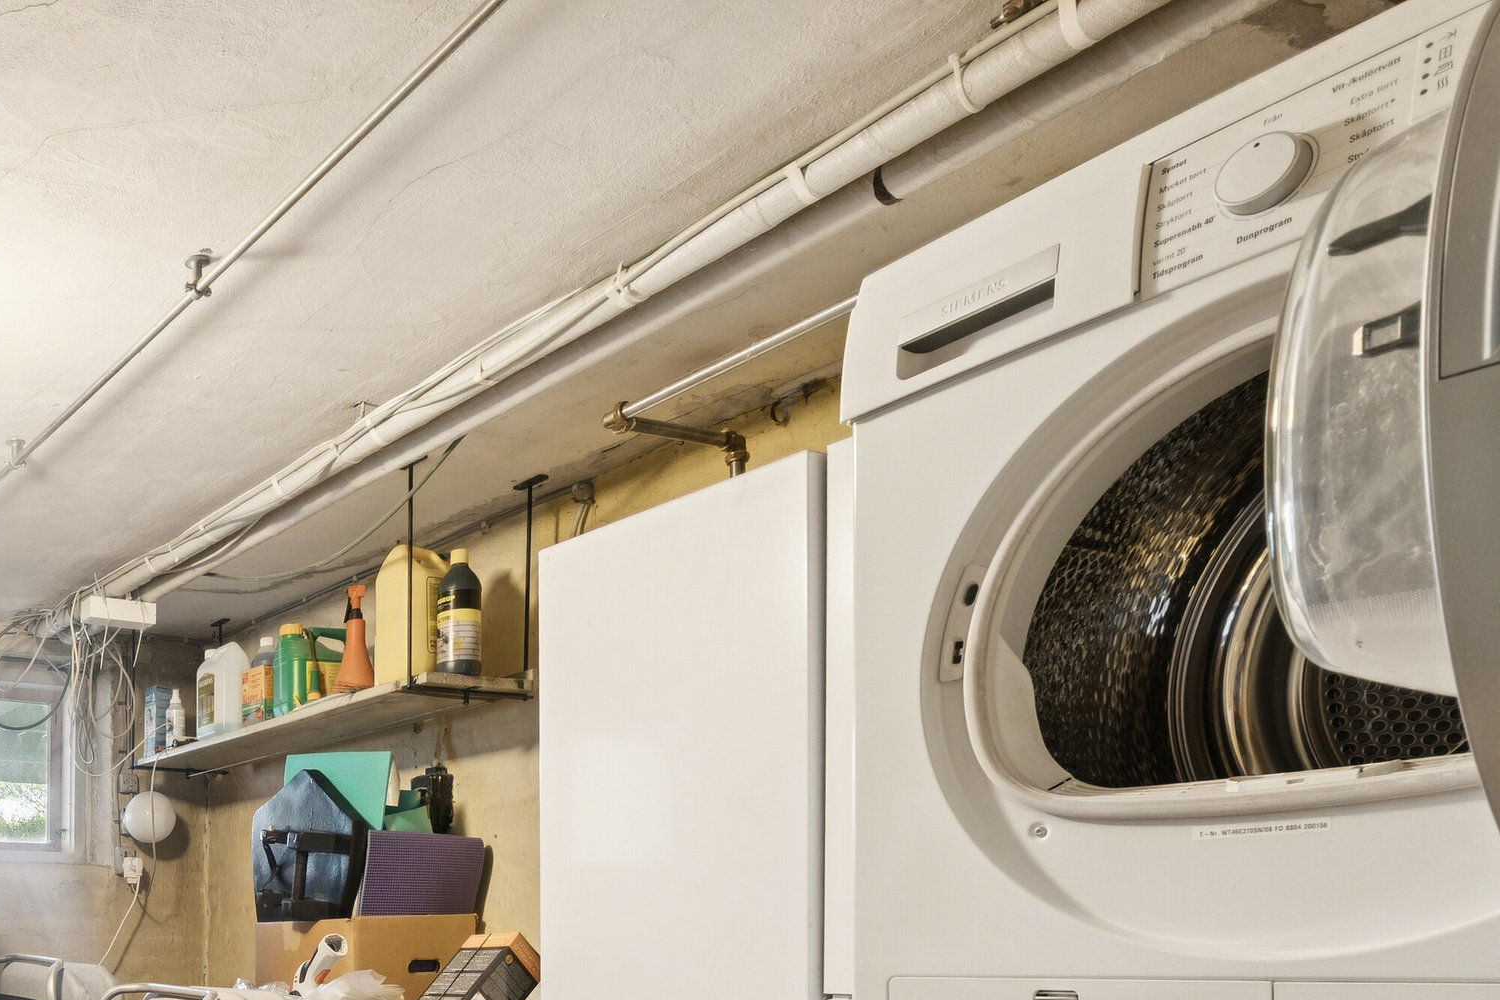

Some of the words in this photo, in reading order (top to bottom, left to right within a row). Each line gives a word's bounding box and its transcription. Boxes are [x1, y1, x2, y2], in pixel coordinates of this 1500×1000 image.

[1350, 91, 1374, 105] Extra
[1377, 79, 1398, 93] torrt
[1263, 112, 1283, 127] Från
[1349, 119, 1394, 143] Skåptorrt
[1162, 159, 1187, 175] Syntet
[1159, 177, 1187, 195] Mycket
[1189, 168, 1206, 180] torrt
[1157, 191, 1193, 212] Skåptorrt
[1156, 209, 1192, 230] Stryktorrt
[1236, 216, 1292, 245] Dunprogram
[1154, 223, 1202, 248] Supersnabb
[1152, 254, 1203, 280] Tidsprogram
[1153, 252, 1175, 266] varmt
[941, 279, 1006, 316] SIEMENS
